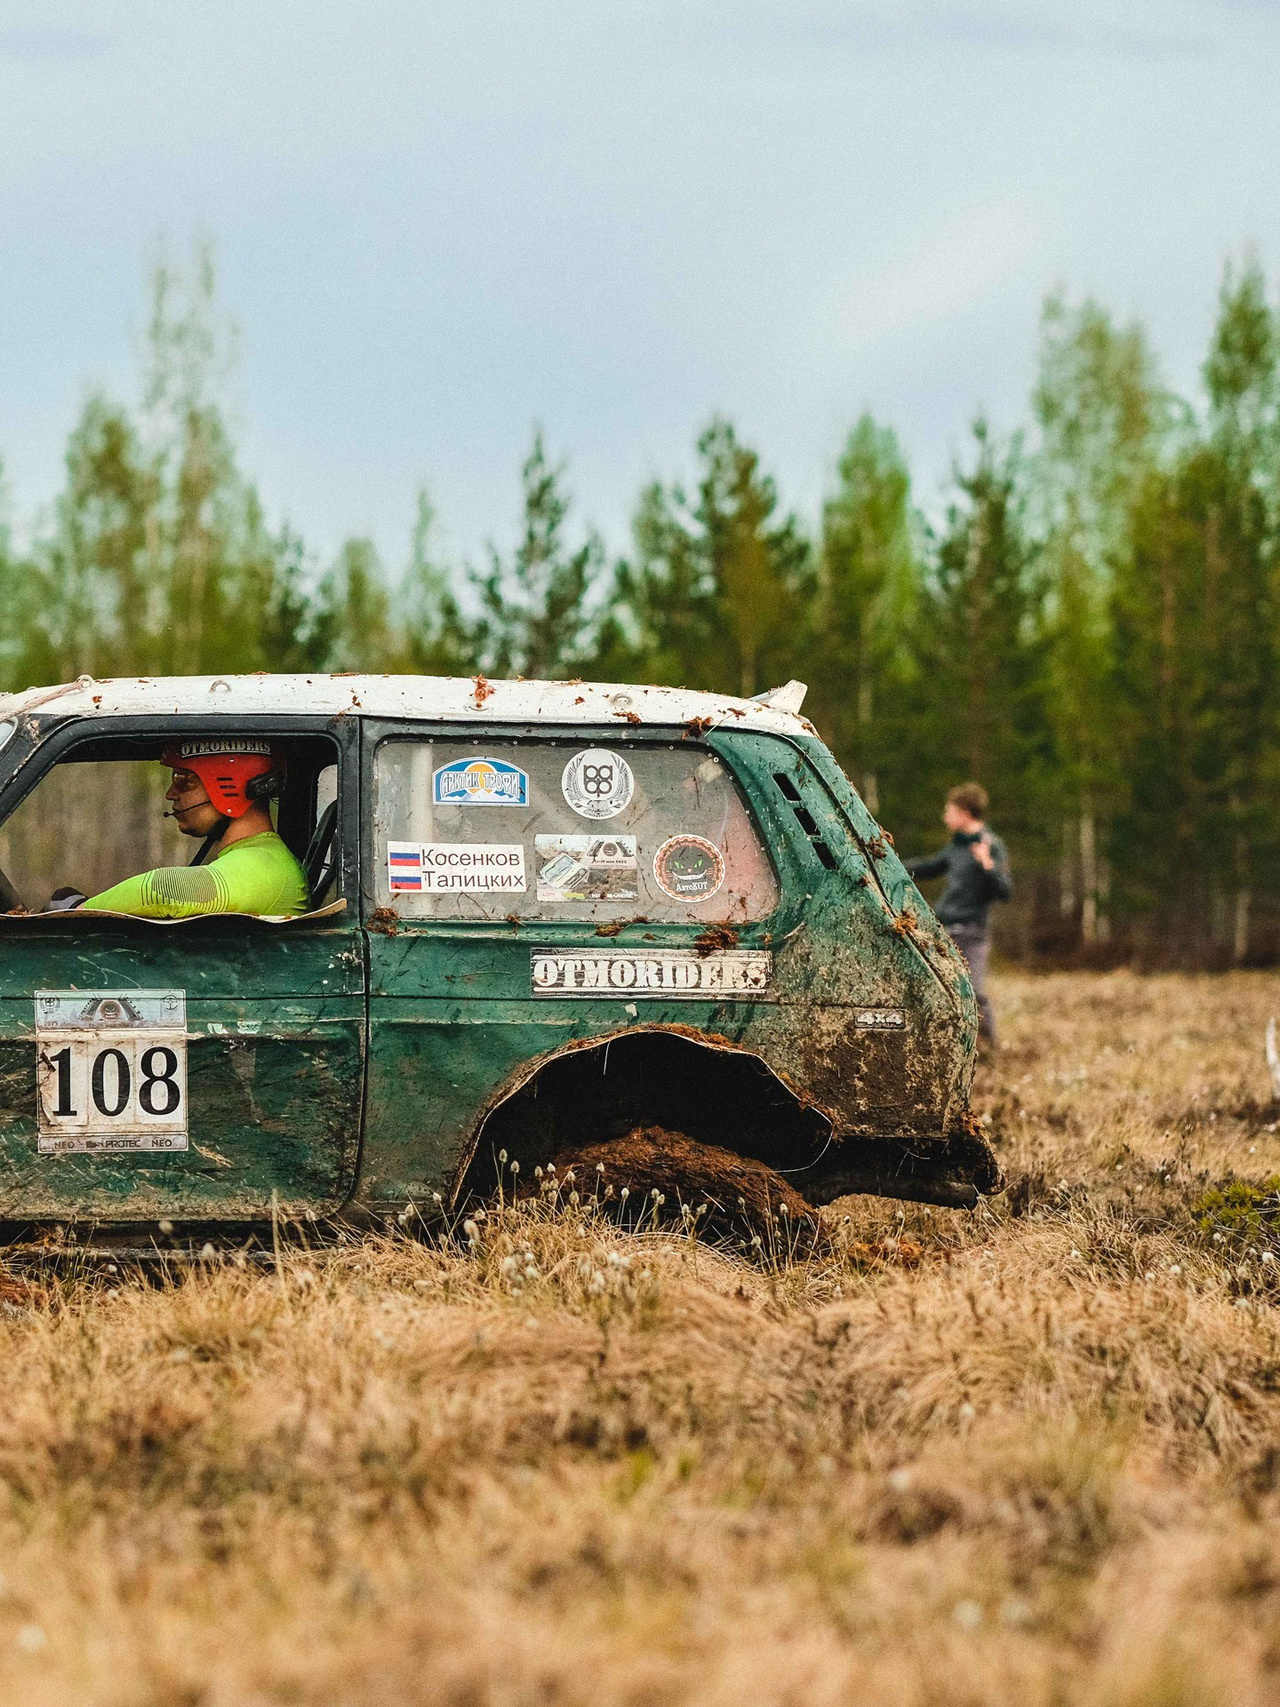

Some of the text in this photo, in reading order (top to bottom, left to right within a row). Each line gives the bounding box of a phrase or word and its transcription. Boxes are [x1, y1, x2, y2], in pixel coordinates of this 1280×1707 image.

[181, 740, 272, 755] OTMORIDERS
[422, 848, 520, 866] Косенков
[422, 870, 525, 890] Талицких
[532, 959, 767, 989] OTMORIDERS
[49, 1046, 181, 1117] 108
[54, 1141, 75, 1149] NEO
[152, 1139, 173, 1148] NEO
